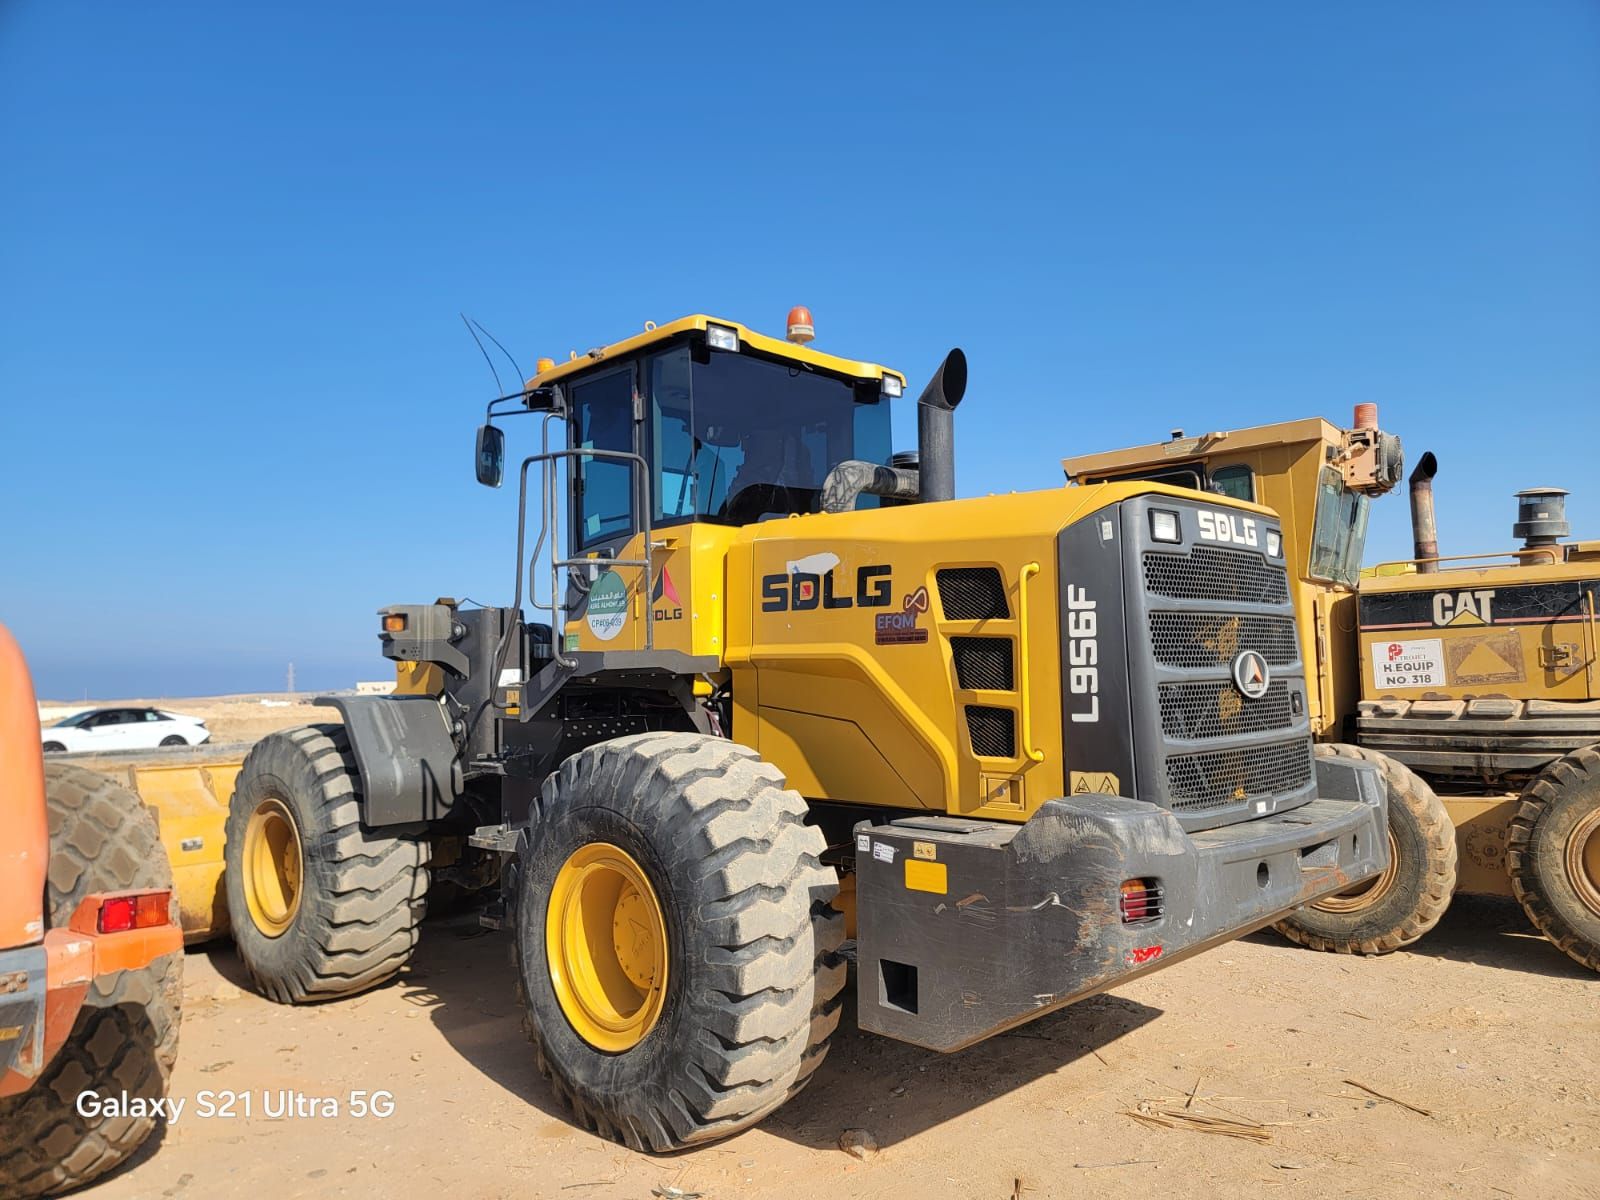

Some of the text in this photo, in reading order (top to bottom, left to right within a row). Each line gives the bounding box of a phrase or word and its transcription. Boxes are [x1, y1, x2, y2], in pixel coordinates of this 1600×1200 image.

[1197, 510, 1258, 547] SDLG
[762, 564, 892, 612] SDLG
[653, 608, 682, 621] DLG
[877, 614, 914, 629] EFQM
[1432, 590, 1496, 626] CAT
[1067, 583, 1099, 723] L956F
[1411, 674, 1432, 684] 318
